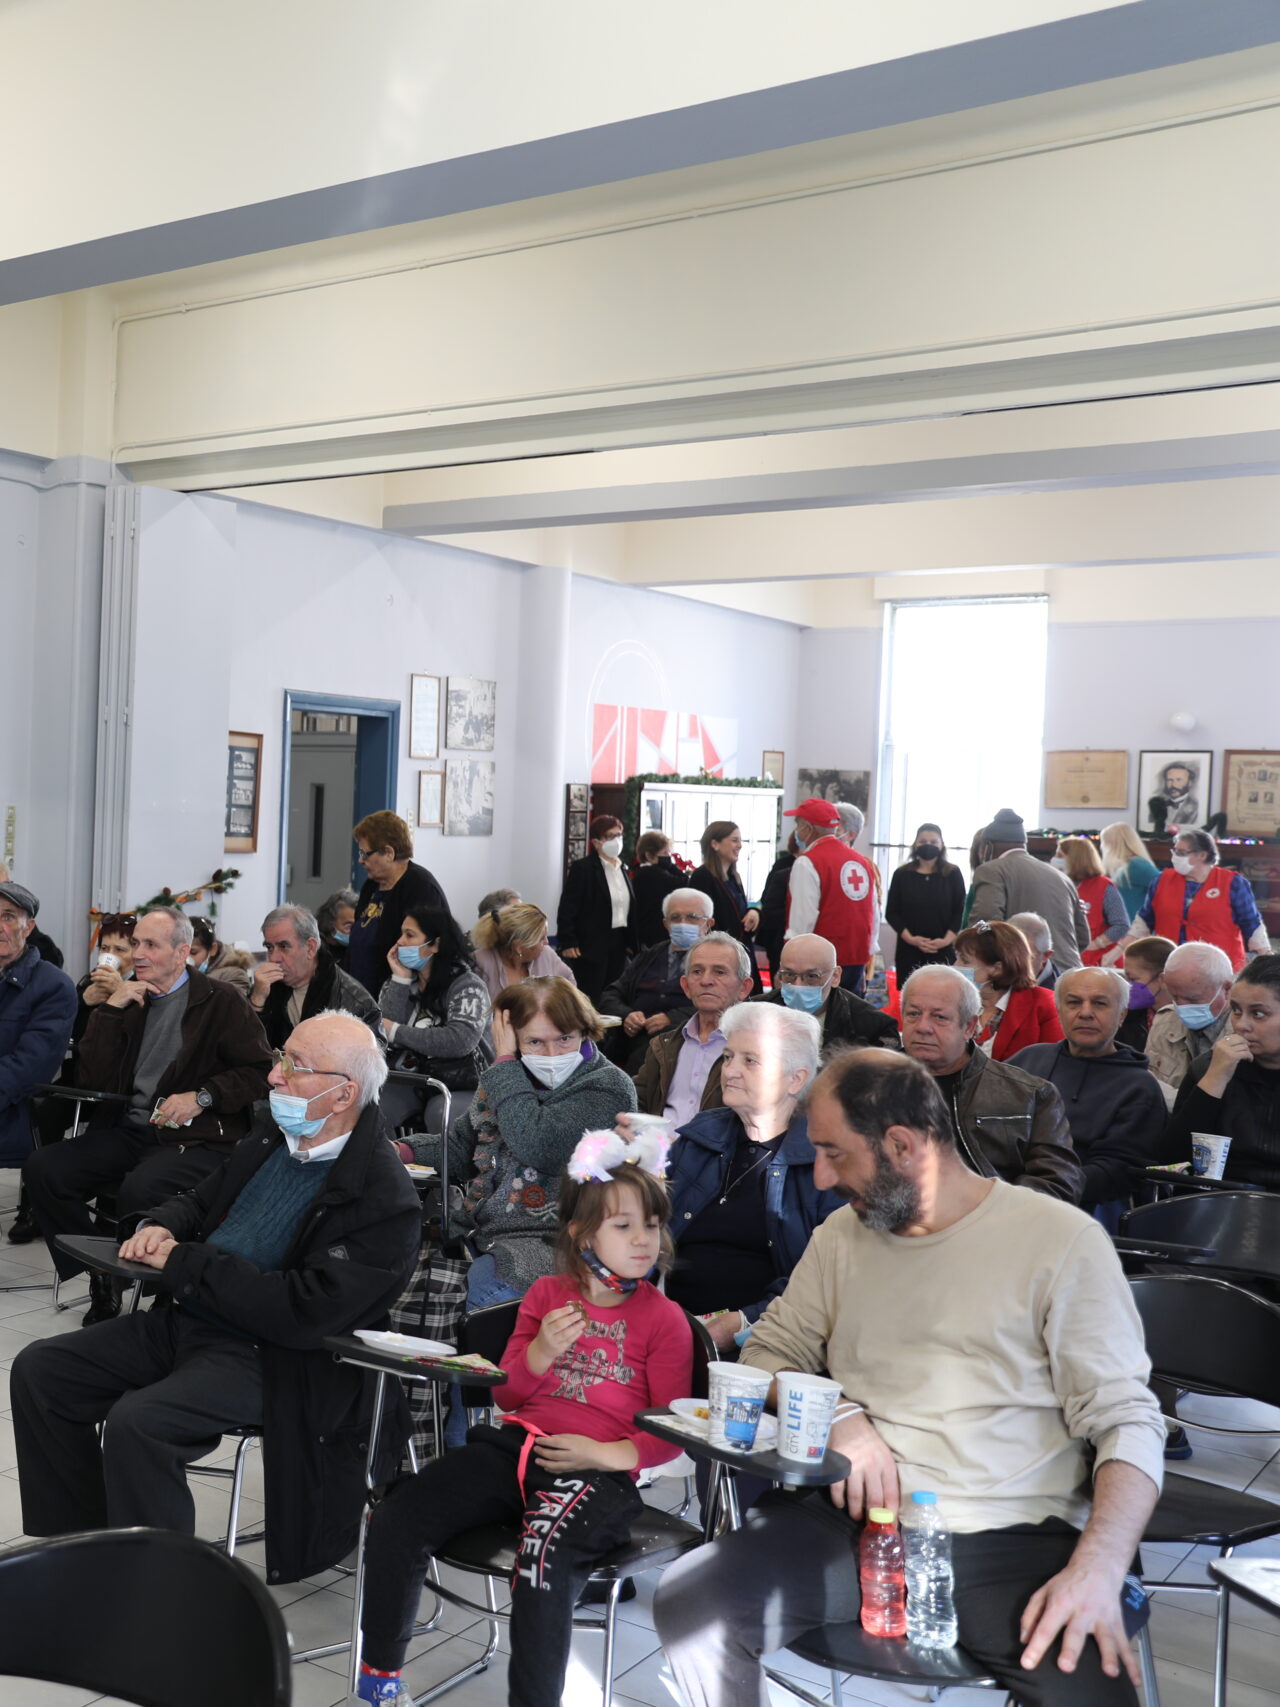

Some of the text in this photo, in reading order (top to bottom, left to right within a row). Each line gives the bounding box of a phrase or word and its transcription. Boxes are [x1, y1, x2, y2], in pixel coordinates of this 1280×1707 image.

[459, 998, 479, 1017] M
[787, 1390, 803, 1454] CITY LIFE
[519, 1478, 584, 1588] STREET
